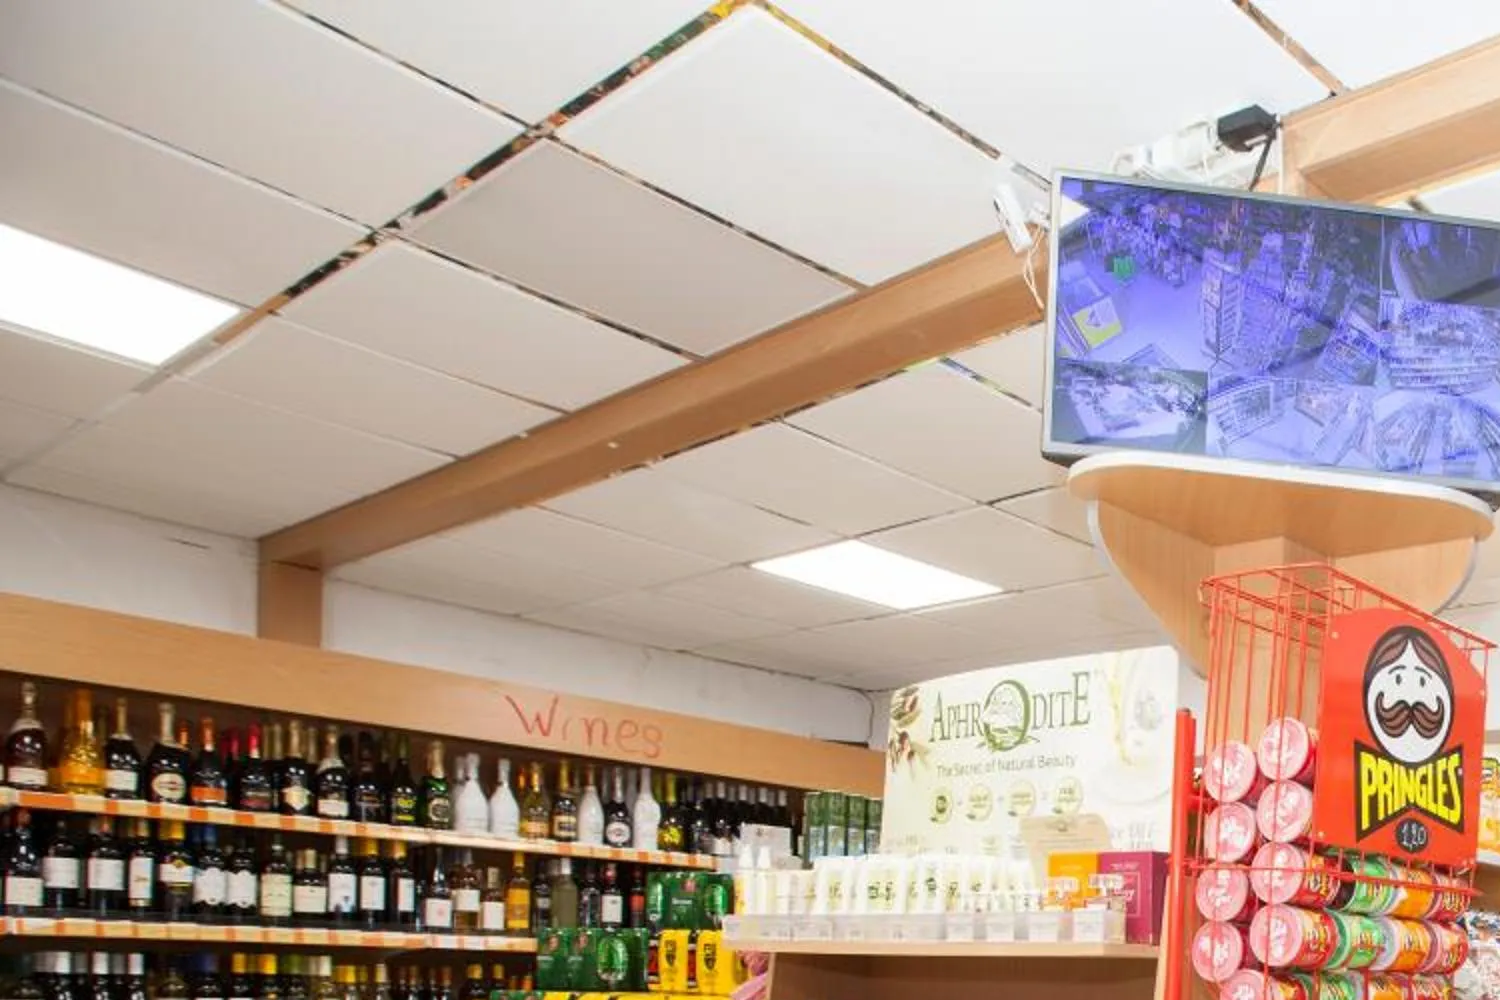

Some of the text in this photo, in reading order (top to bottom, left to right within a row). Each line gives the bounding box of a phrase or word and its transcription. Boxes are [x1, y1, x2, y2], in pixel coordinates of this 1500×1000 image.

[505, 695, 664, 759] Wines
[929, 671, 1091, 751] APHRODITE
[997, 757, 1035, 772] Natural
[1038, 754, 1075, 768] Beauty
[1360, 751, 1461, 831] PRINGLES
